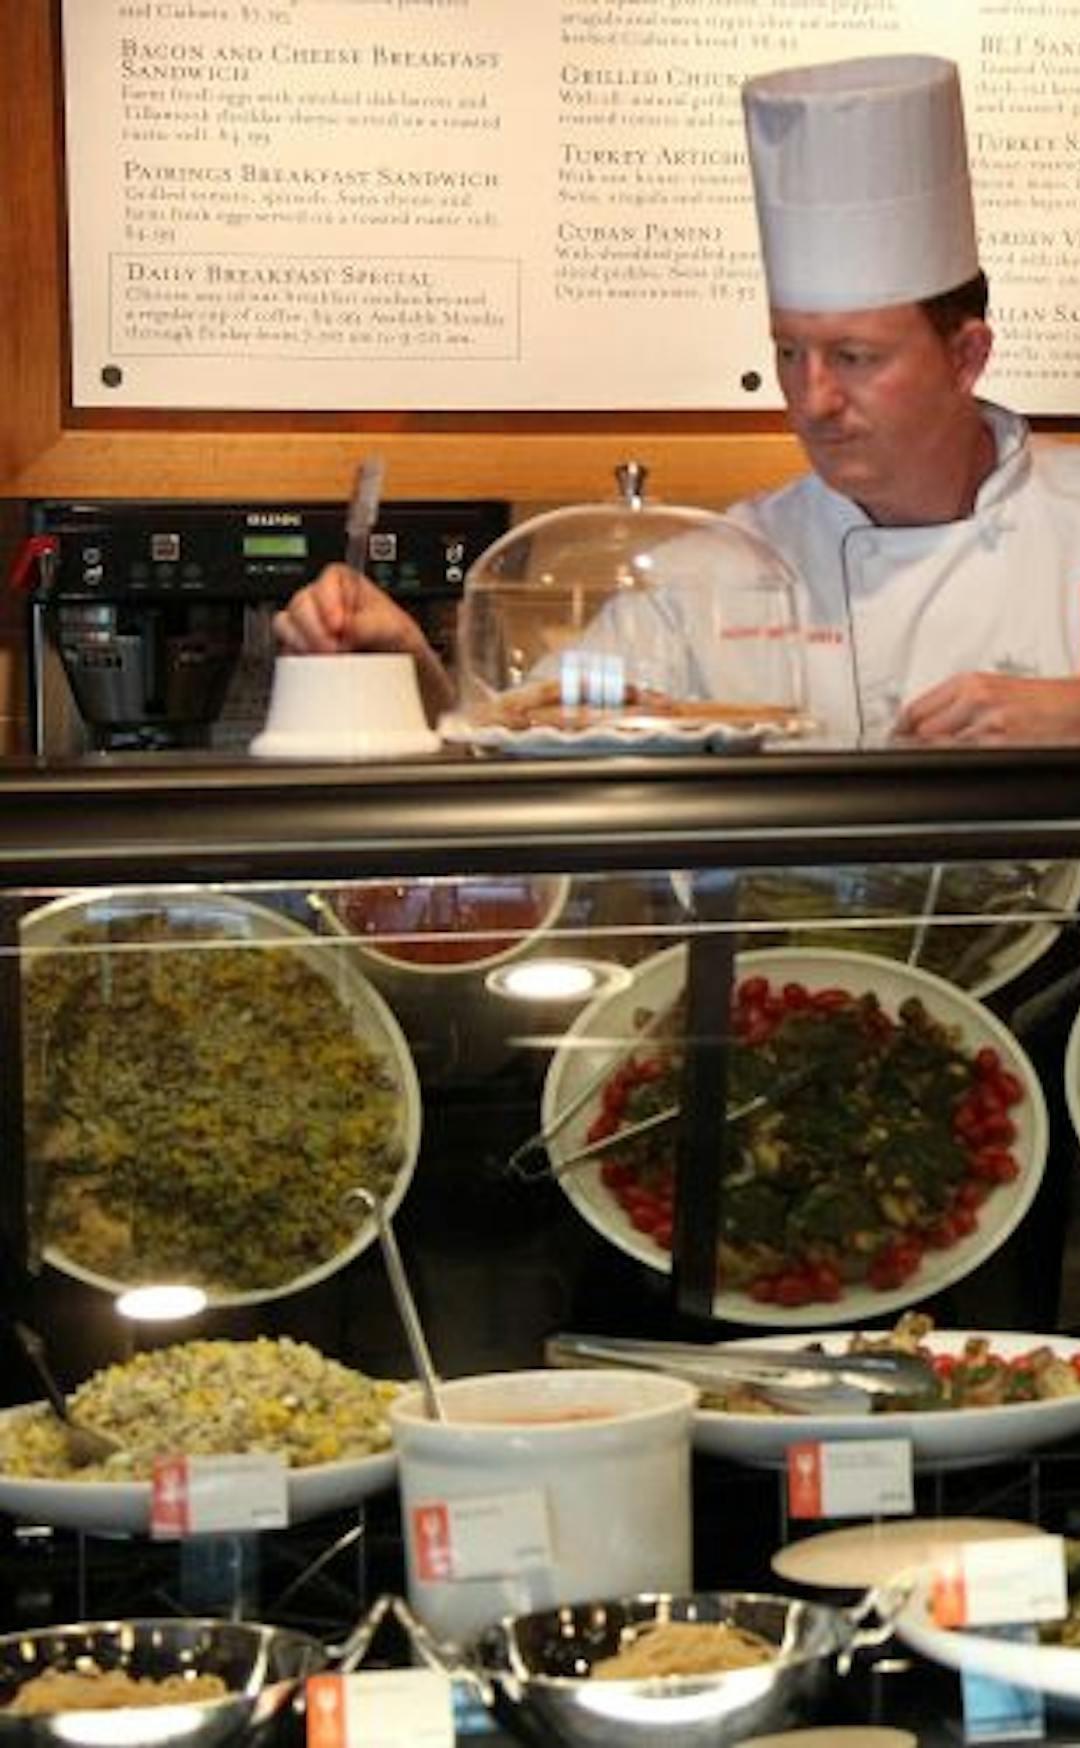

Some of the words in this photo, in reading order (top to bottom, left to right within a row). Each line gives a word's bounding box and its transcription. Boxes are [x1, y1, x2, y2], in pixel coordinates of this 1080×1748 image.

[120, 38, 204, 62] BACON
[213, 46, 265, 62] AND
[271, 43, 360, 65] CHEESE
[372, 43, 501, 69] BREAKFAST
[120, 60, 251, 82] SANDWICH
[560, 64, 660, 87] GRILLED
[976, 132, 1061, 152] TURKEY
[558, 143, 647, 166] TURKEY
[123, 158, 232, 183] PAIRINGS
[240, 162, 371, 187] BREAKFAST
[376, 167, 499, 189] SANDWICH
[556, 221, 638, 243] CUBAN
[644, 222, 725, 243] PANINI
[976, 232, 1056, 248] ARDEN
[127, 261, 198, 283] DAILY
[206, 264, 333, 287] BREAKFAST
[341, 265, 433, 288] SPECIAL
